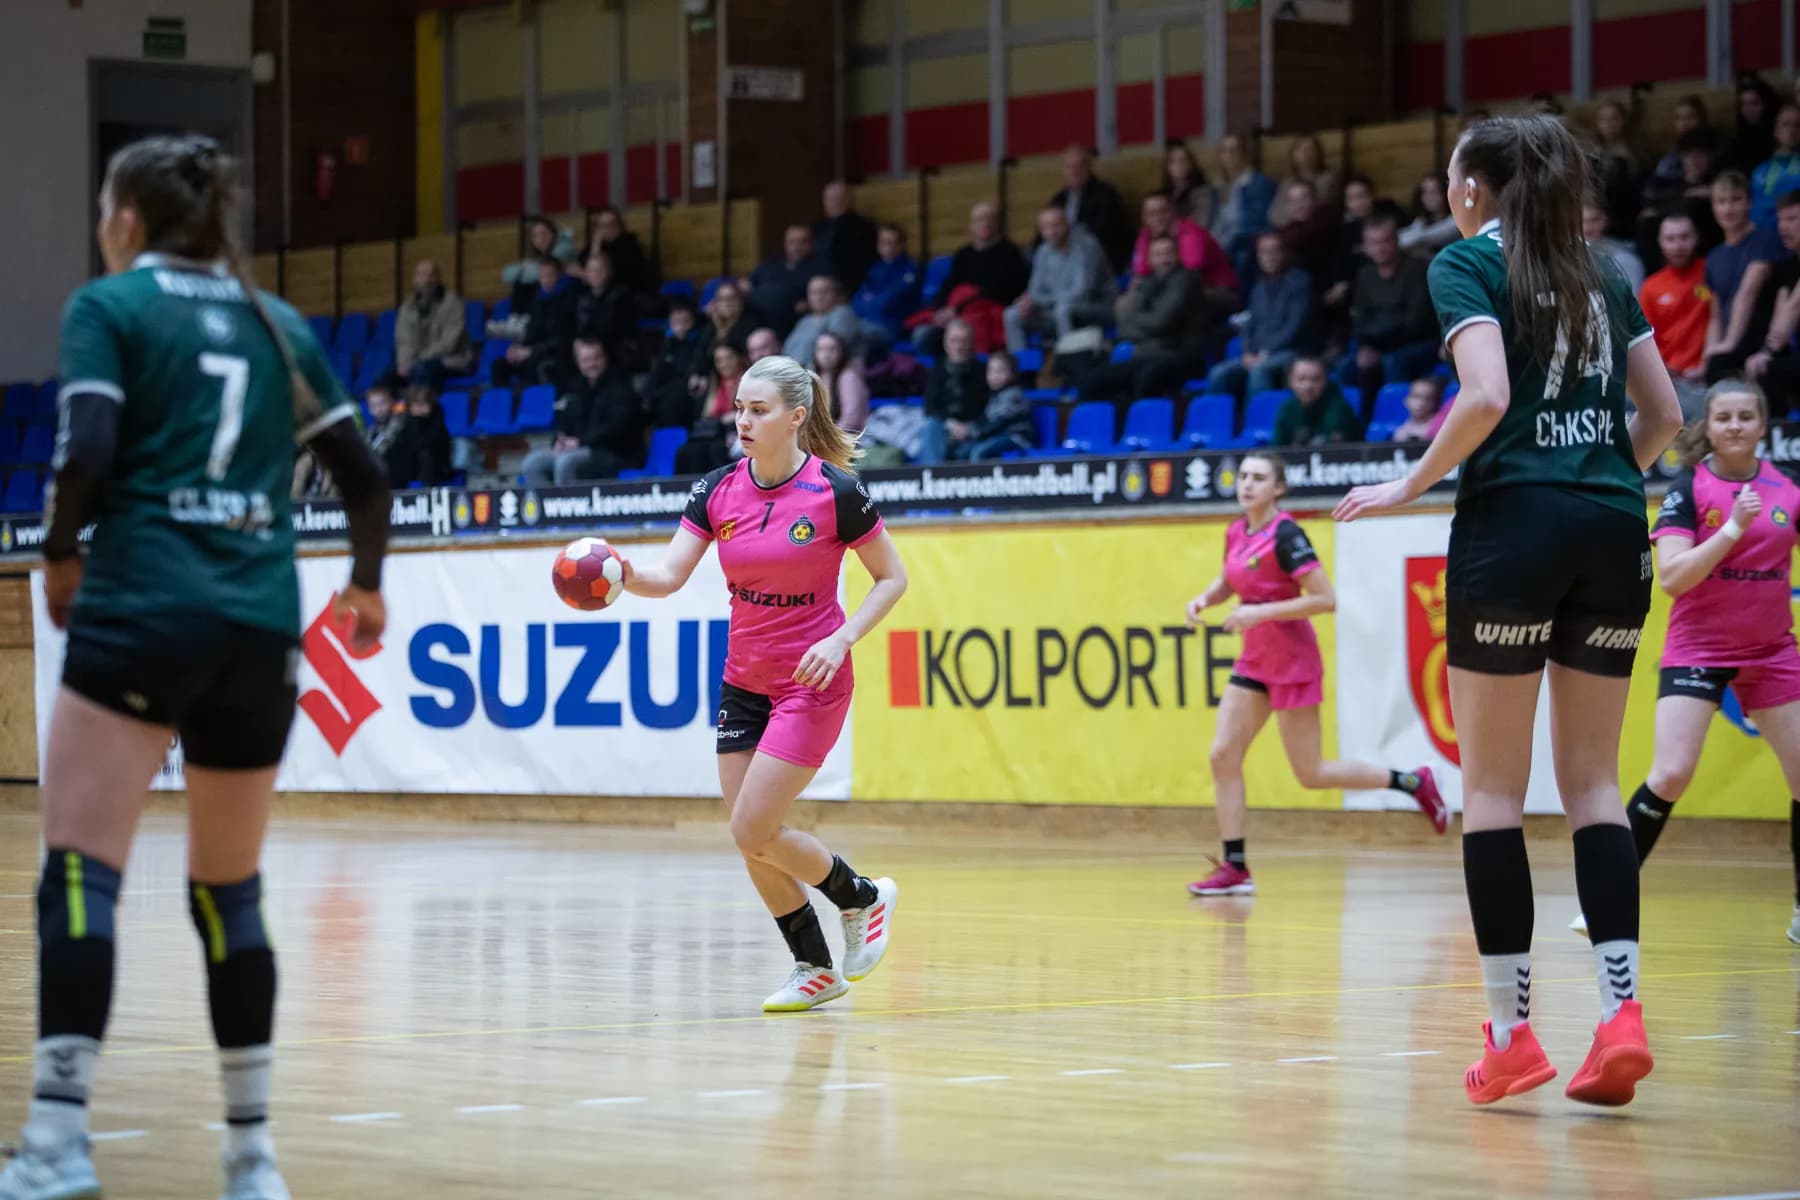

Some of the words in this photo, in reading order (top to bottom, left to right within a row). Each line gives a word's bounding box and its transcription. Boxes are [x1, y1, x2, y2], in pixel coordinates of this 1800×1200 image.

[199, 352, 250, 482] 7
[868, 462, 1117, 503] www.koronahandball.pl
[760, 502, 775, 533] 7
[739, 588, 815, 608] SUZUKI
[1474, 620, 1553, 646] WHITE
[924, 625, 1236, 709] KOLPORTE
